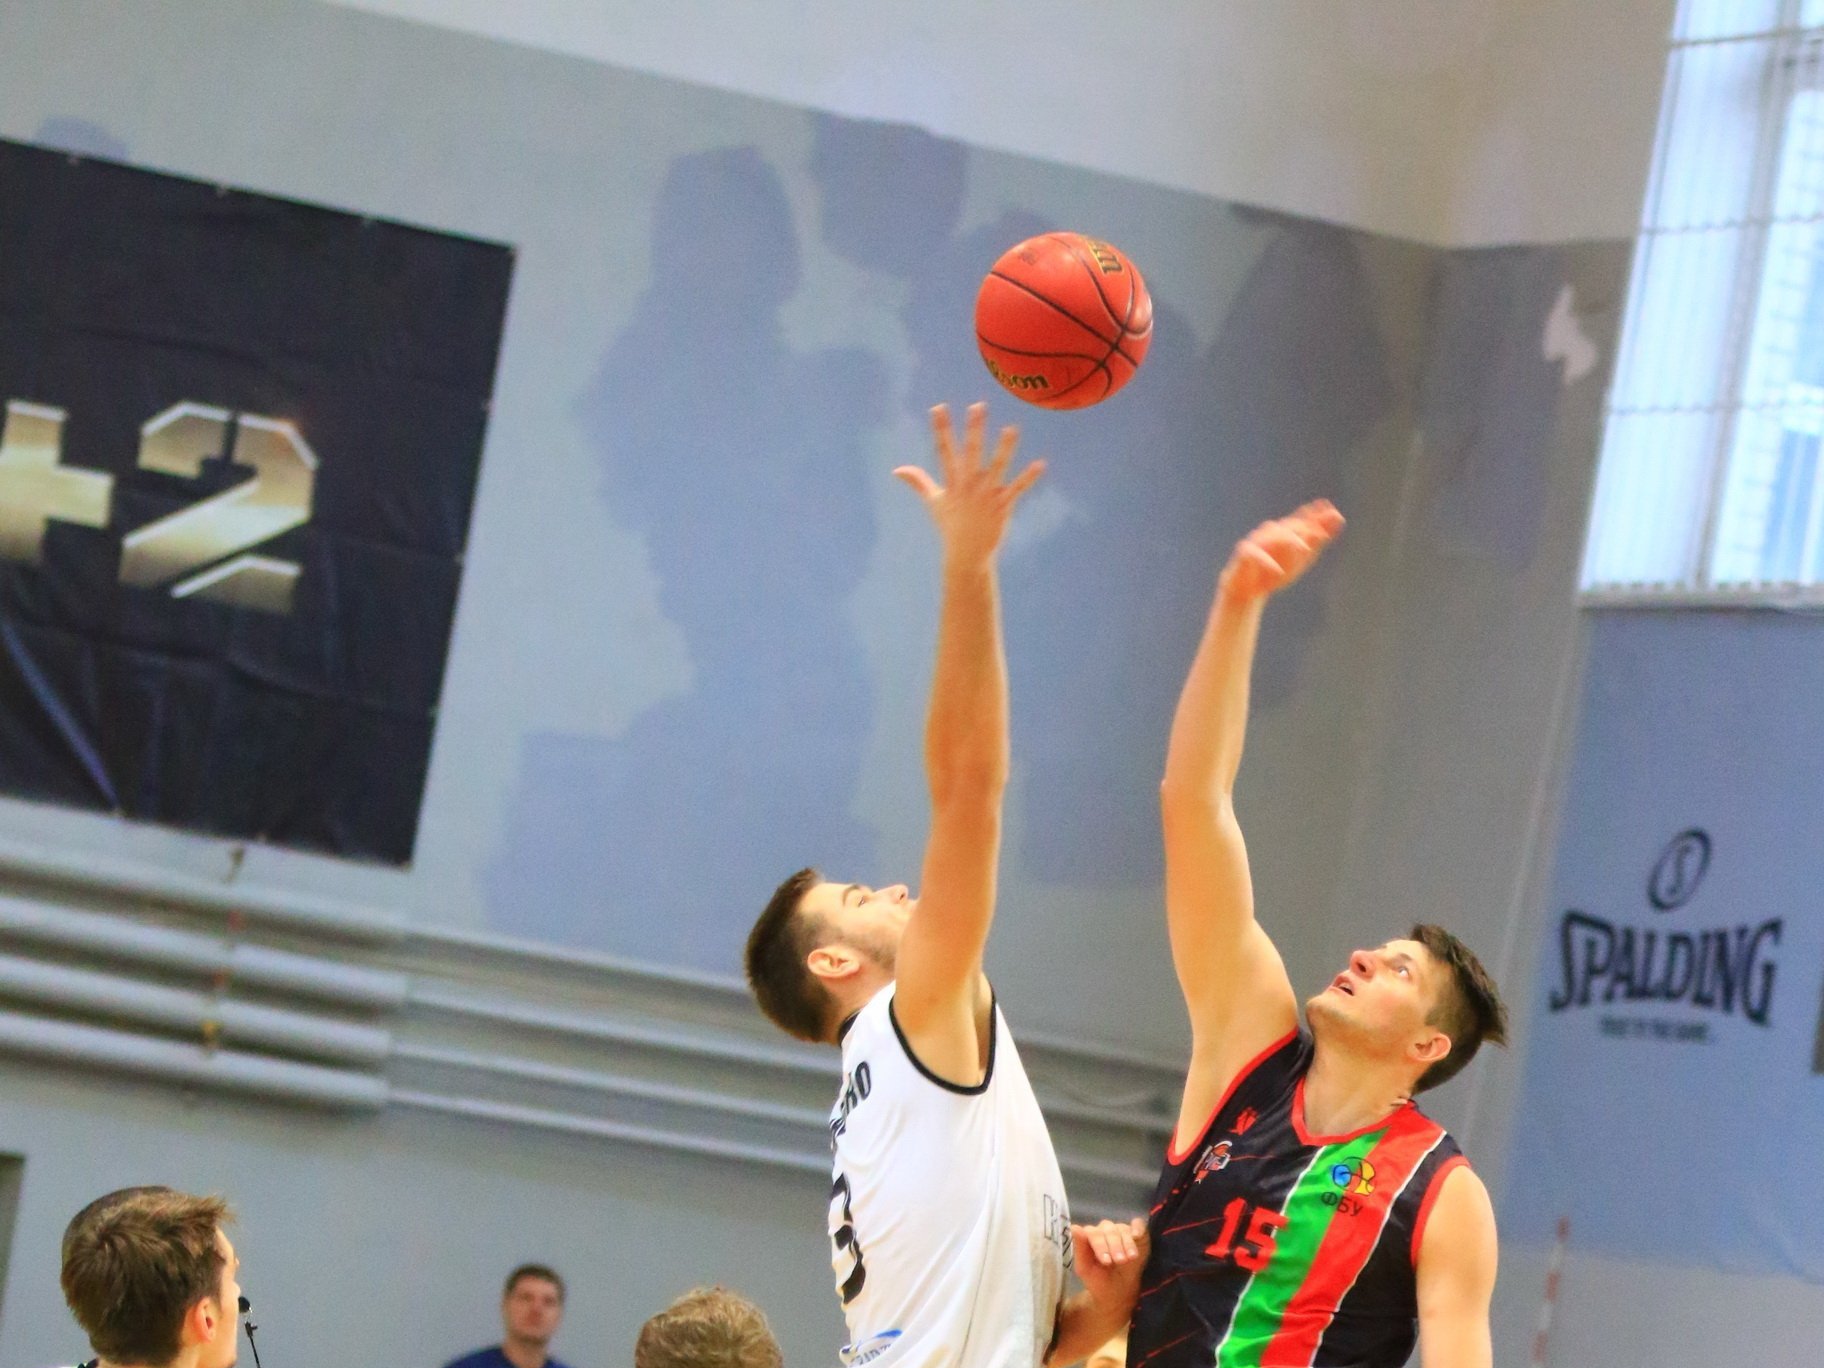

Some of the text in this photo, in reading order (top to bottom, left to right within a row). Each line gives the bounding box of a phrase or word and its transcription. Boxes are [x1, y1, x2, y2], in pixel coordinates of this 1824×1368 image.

[1548, 909, 1783, 1028] SPALDING
[1205, 1197, 1289, 1273] 15
[1320, 1191, 1364, 1217] ФБУ
